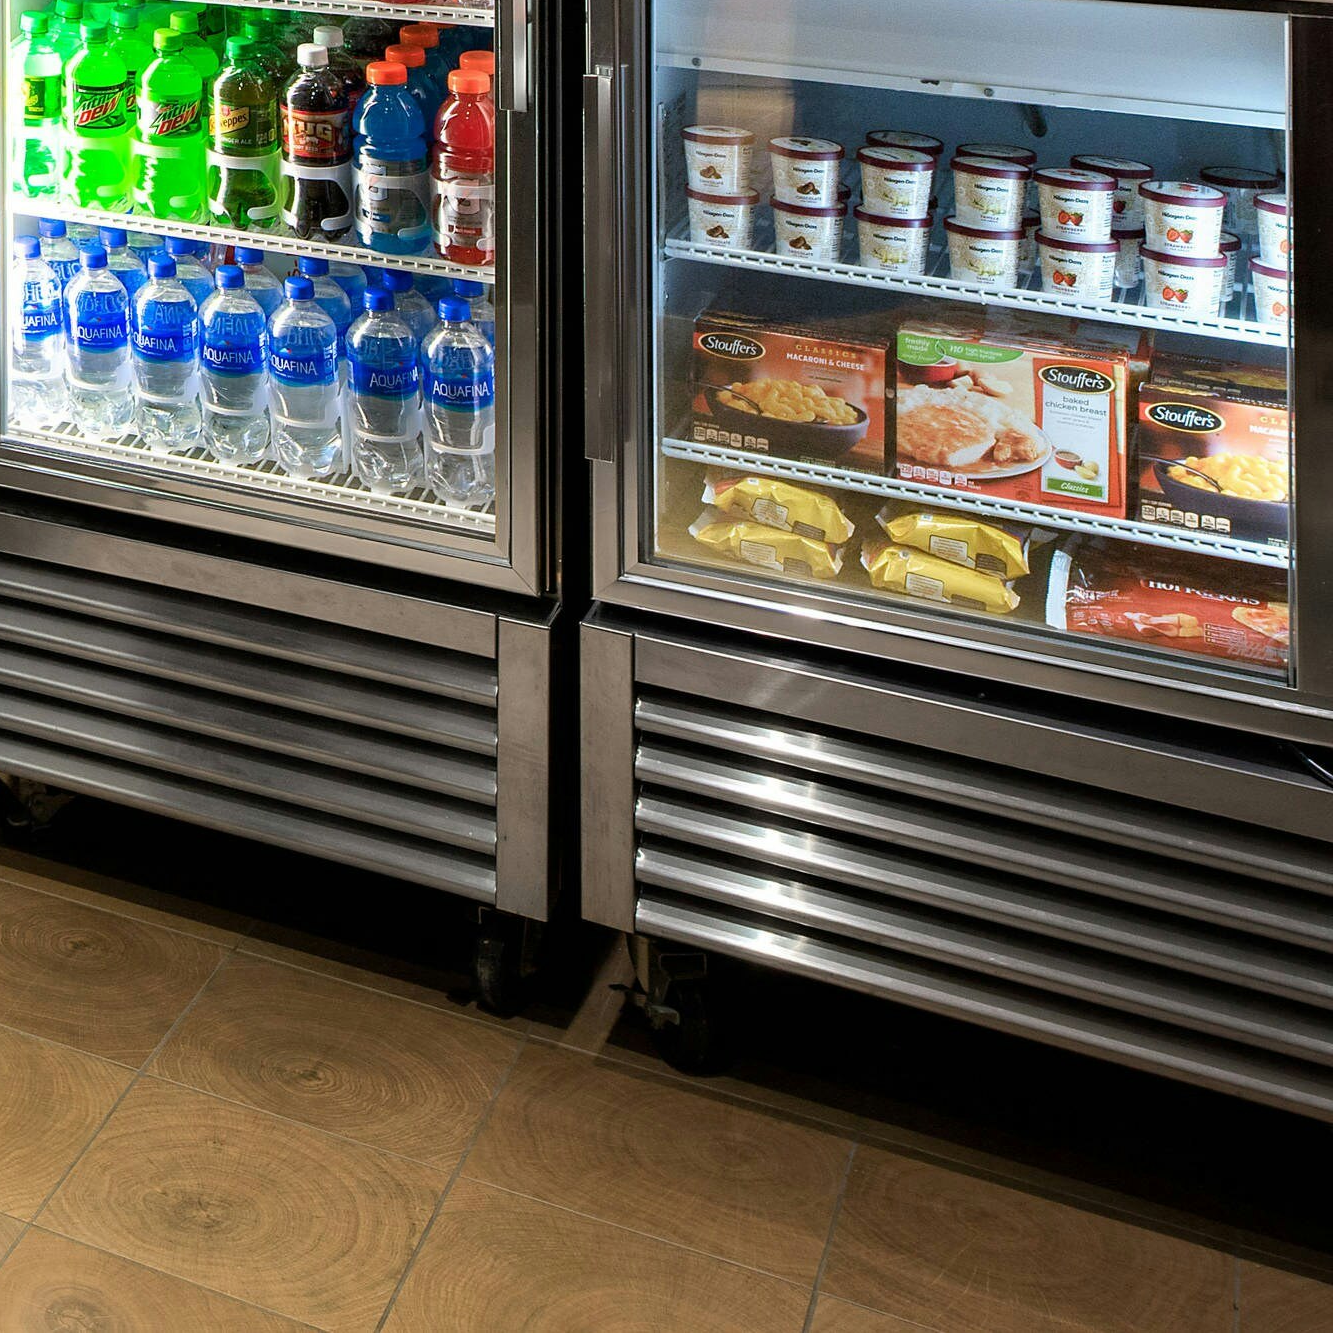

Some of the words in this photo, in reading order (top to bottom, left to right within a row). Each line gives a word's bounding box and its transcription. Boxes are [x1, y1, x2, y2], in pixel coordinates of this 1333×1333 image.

[202, 344, 255, 365] AQUAFINA
[706, 336, 758, 356] Stouffer's
[786, 352, 827, 366] MACARONI
[369, 366, 419, 390] AQUAFINA
[1048, 368, 1106, 391] Stouffer's
[432, 379, 491, 399] AQUAFINA
[1045, 400, 1078, 413] chicken
[1154, 406, 1216, 429] Stouffer's
[1060, 482, 1090, 495] Classics
